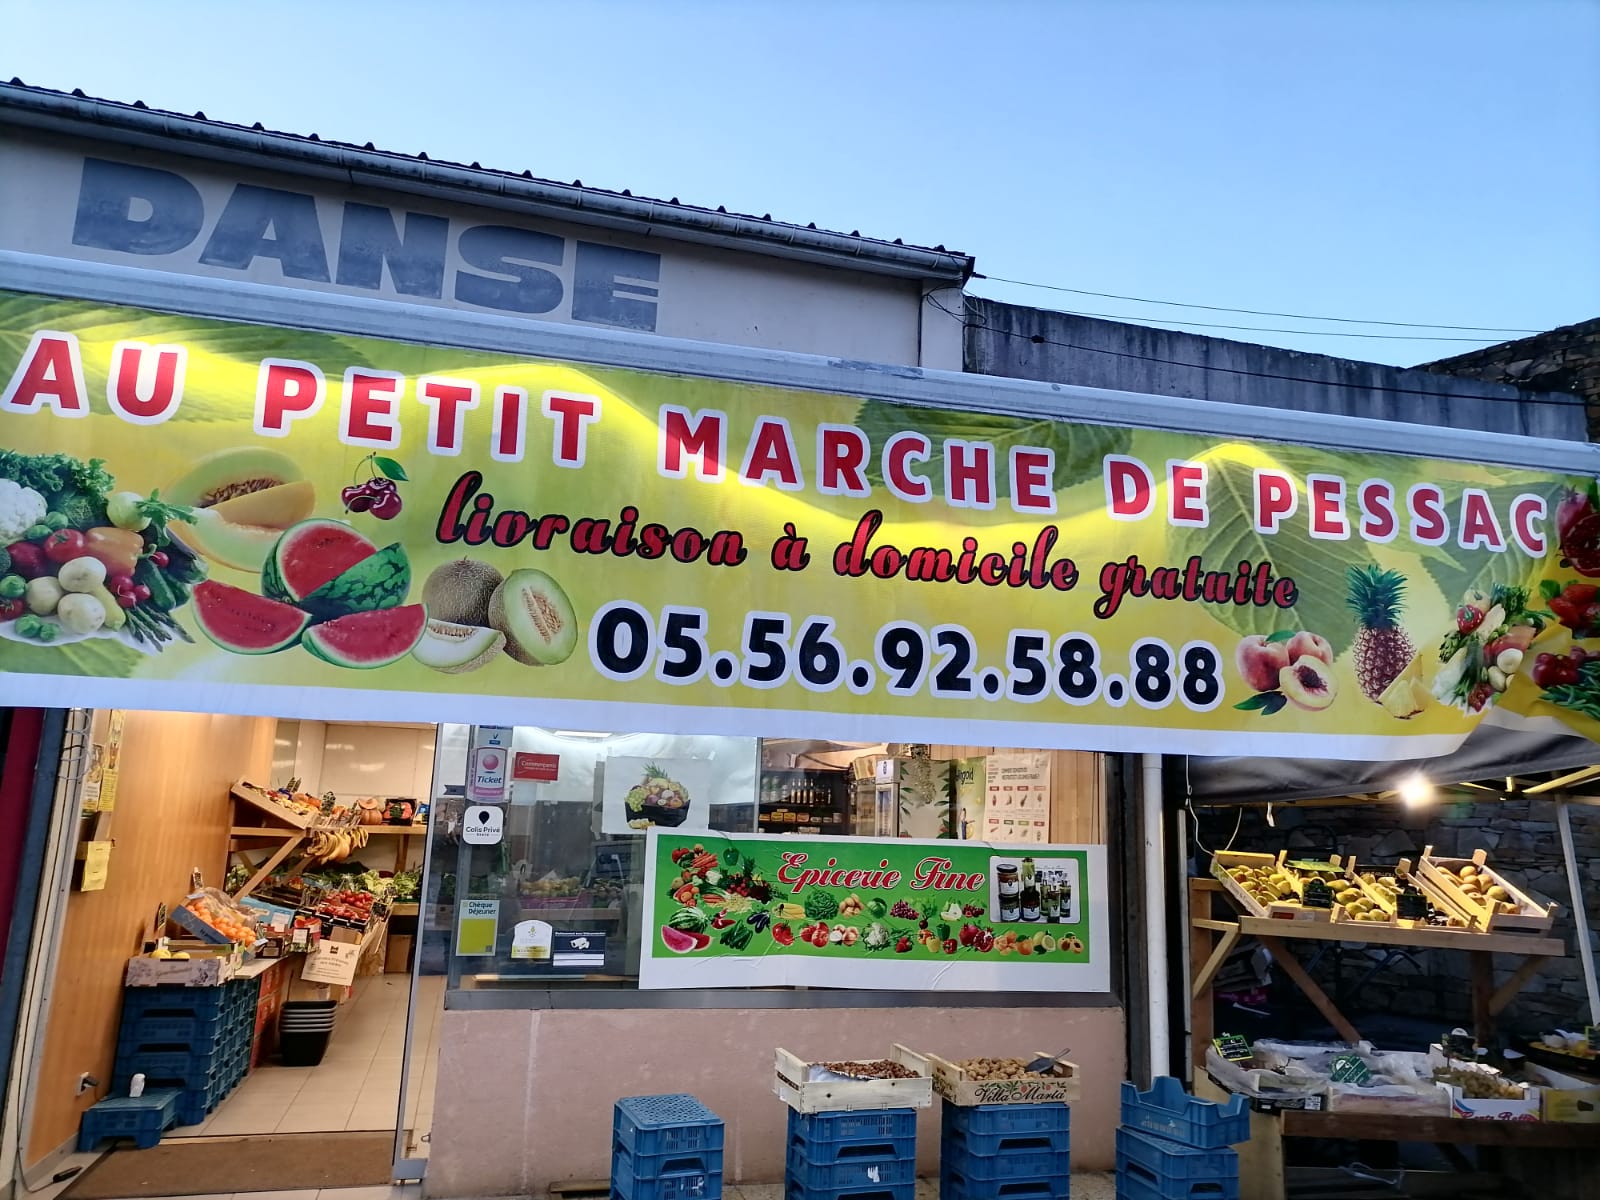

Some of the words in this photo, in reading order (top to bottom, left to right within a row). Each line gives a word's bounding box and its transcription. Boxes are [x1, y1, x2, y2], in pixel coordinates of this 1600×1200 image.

[72, 156, 661, 332] DANSE
[6, 334, 184, 421] AU
[257, 361, 598, 466] PETIT
[660, 407, 1055, 511] MARCHE
[1106, 457, 1207, 525] DE
[1256, 471, 1548, 556] PESSAC
[436, 470, 747, 567] livraison
[771, 522, 810, 571] à
[833, 509, 1079, 590] domicile
[1093, 556, 1299, 619] gratuite
[594, 604, 1222, 709] 05.56.92.58.88
[477, 775, 502, 784] Ticket
[777, 851, 901, 894] Epicerie
[910, 856, 985, 892] Fine
[468, 901, 493, 909] Chèque
[468, 908, 496, 916] Déjeuner
[975, 1087, 1010, 1103] Villa
